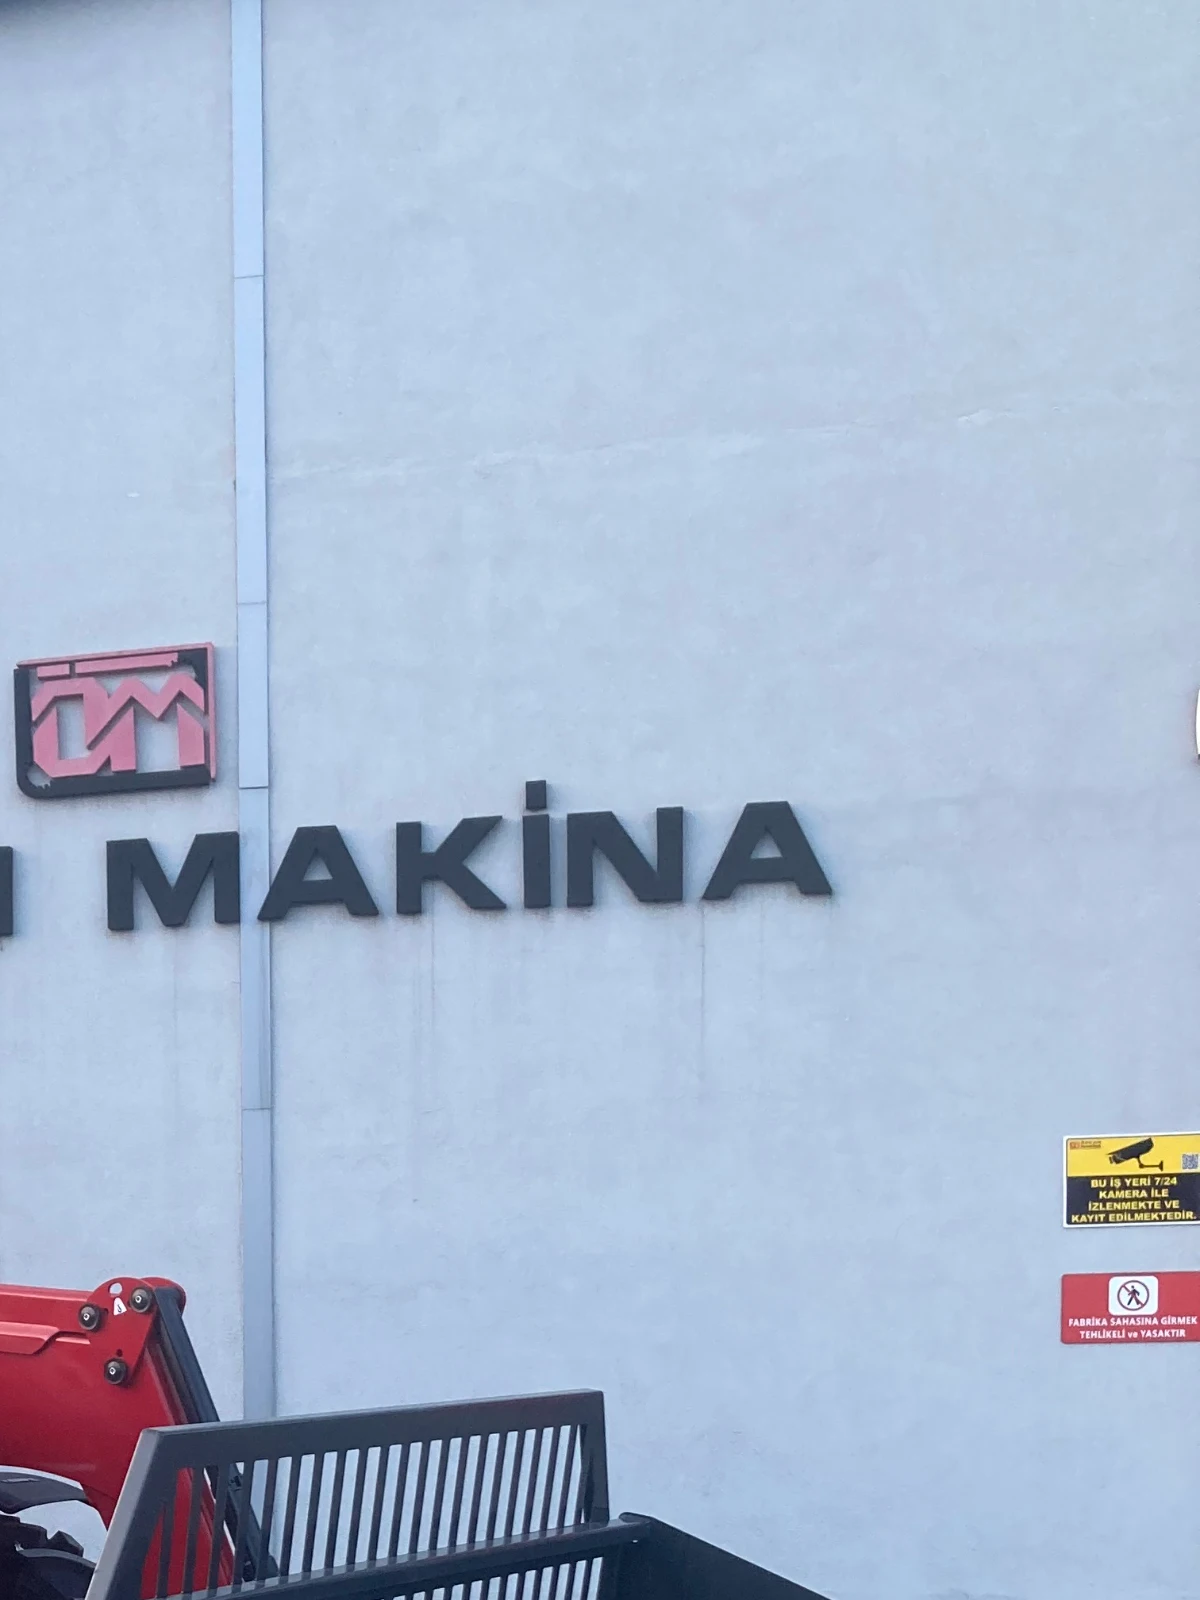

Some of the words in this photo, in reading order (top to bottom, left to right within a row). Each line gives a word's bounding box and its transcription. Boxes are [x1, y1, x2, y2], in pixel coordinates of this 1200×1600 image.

[106, 780, 832, 931] MAKİNA
[1091, 1179, 1107, 1188] BU
[1110, 1177, 1121, 1189] İŞ
[1124, 1175, 1151, 1187] YERİ
[1154, 1177, 1178, 1186] 7/24
[1099, 1189, 1148, 1199] KAMERA
[1151, 1187, 1169, 1198] İLE
[1088, 1200, 1161, 1211] İZLENMEKTE
[1164, 1199, 1179, 1209] VE
[1071, 1213, 1105, 1223] KAYIT
[1109, 1210, 1197, 1222] EDİLMEKTEDİR.
[1068, 1316, 1108, 1327] FABRİKA
[1110, 1316, 1158, 1326] SAHASINA
[1161, 1315, 1198, 1326] GİRMEK
[1080, 1328, 1125, 1339] TEHLİKELİ
[1127, 1331, 1138, 1339] ve
[1140, 1328, 1186, 1338] YASAKTIR
